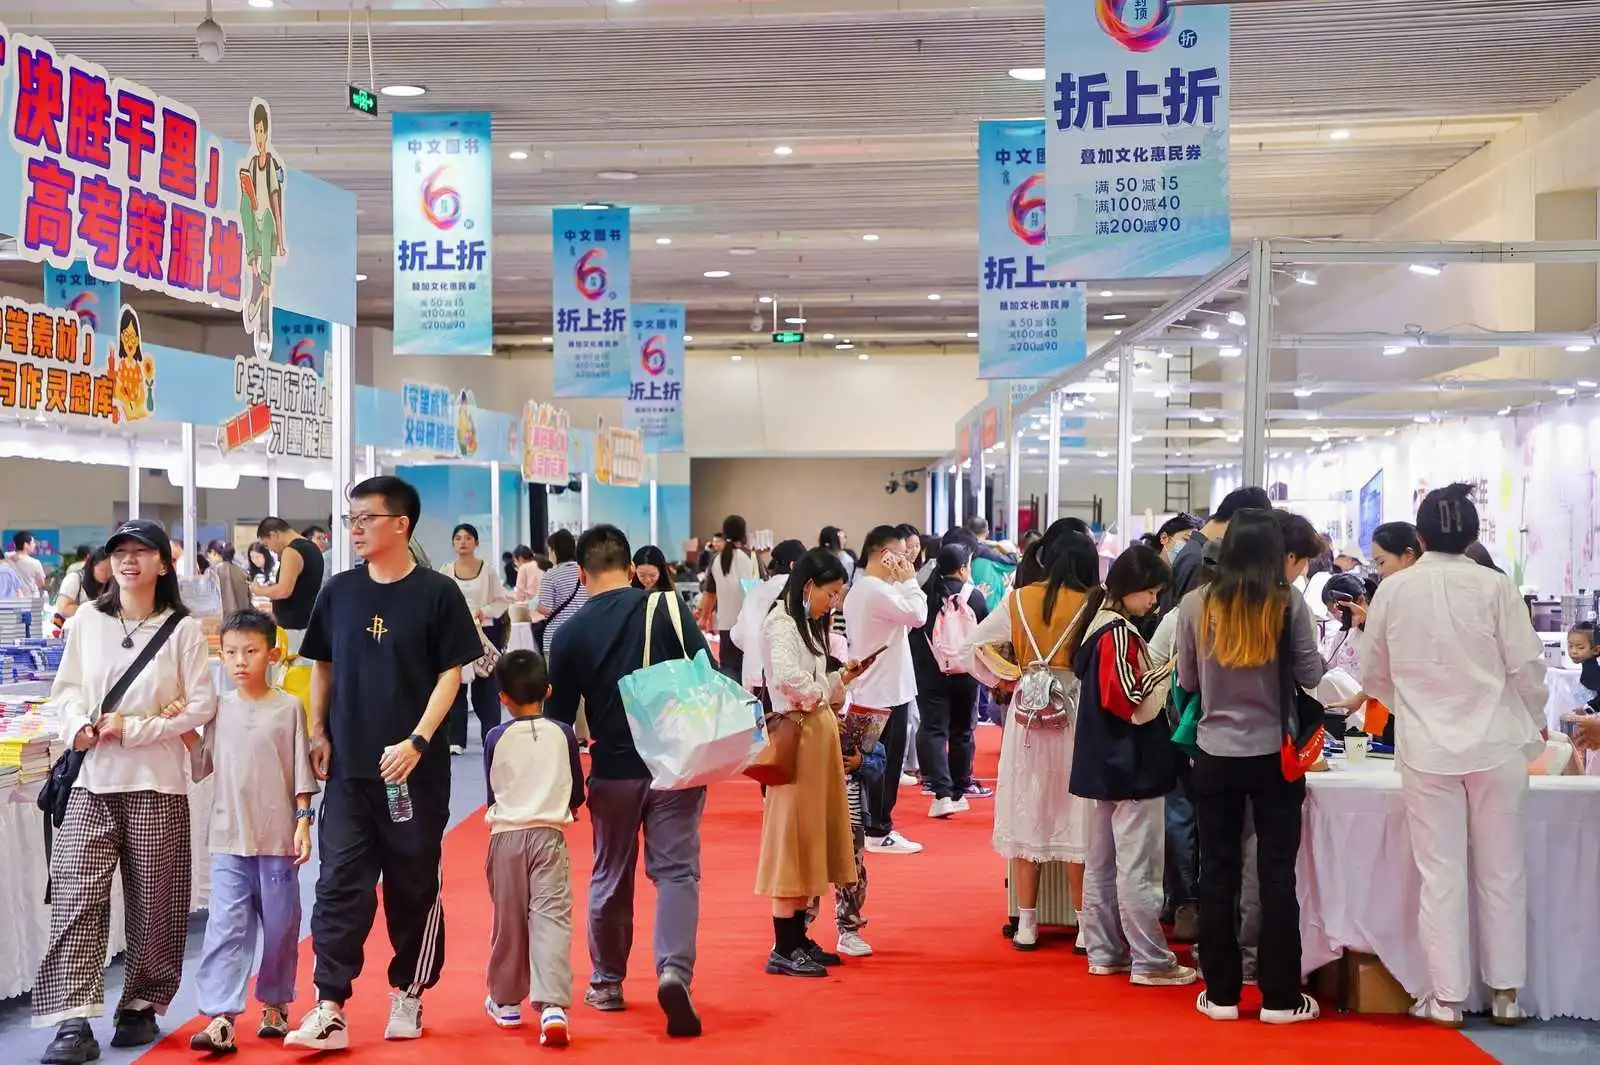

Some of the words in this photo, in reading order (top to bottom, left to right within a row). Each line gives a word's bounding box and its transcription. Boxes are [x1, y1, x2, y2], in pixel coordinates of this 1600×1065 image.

[1181, 31, 1197, 47] 折
[1053, 67, 1221, 131] 折上折
[0, 34, 219, 208] 决胜千里」
[407, 138, 480, 155] 中文图书
[1080, 145, 1202, 165] 叠加文化惠民券
[420, 164, 461, 231] 6
[1095, 195, 1181, 214] 满100减40
[25, 156, 243, 302] 高考策源地
[564, 229, 621, 241] 中文图书
[1095, 217, 1181, 236] 满200减90
[398, 240, 486, 271] 折上折
[56, 273, 110, 286] 中文图
[574, 247, 607, 301] 6
[984, 255, 1077, 290] 折上
[557, 308, 626, 332] 折上折
[0, 305, 92, 366] 笔素材」
[0, 360, 113, 418] 写作灵感库
[628, 381, 681, 401] 折上折
